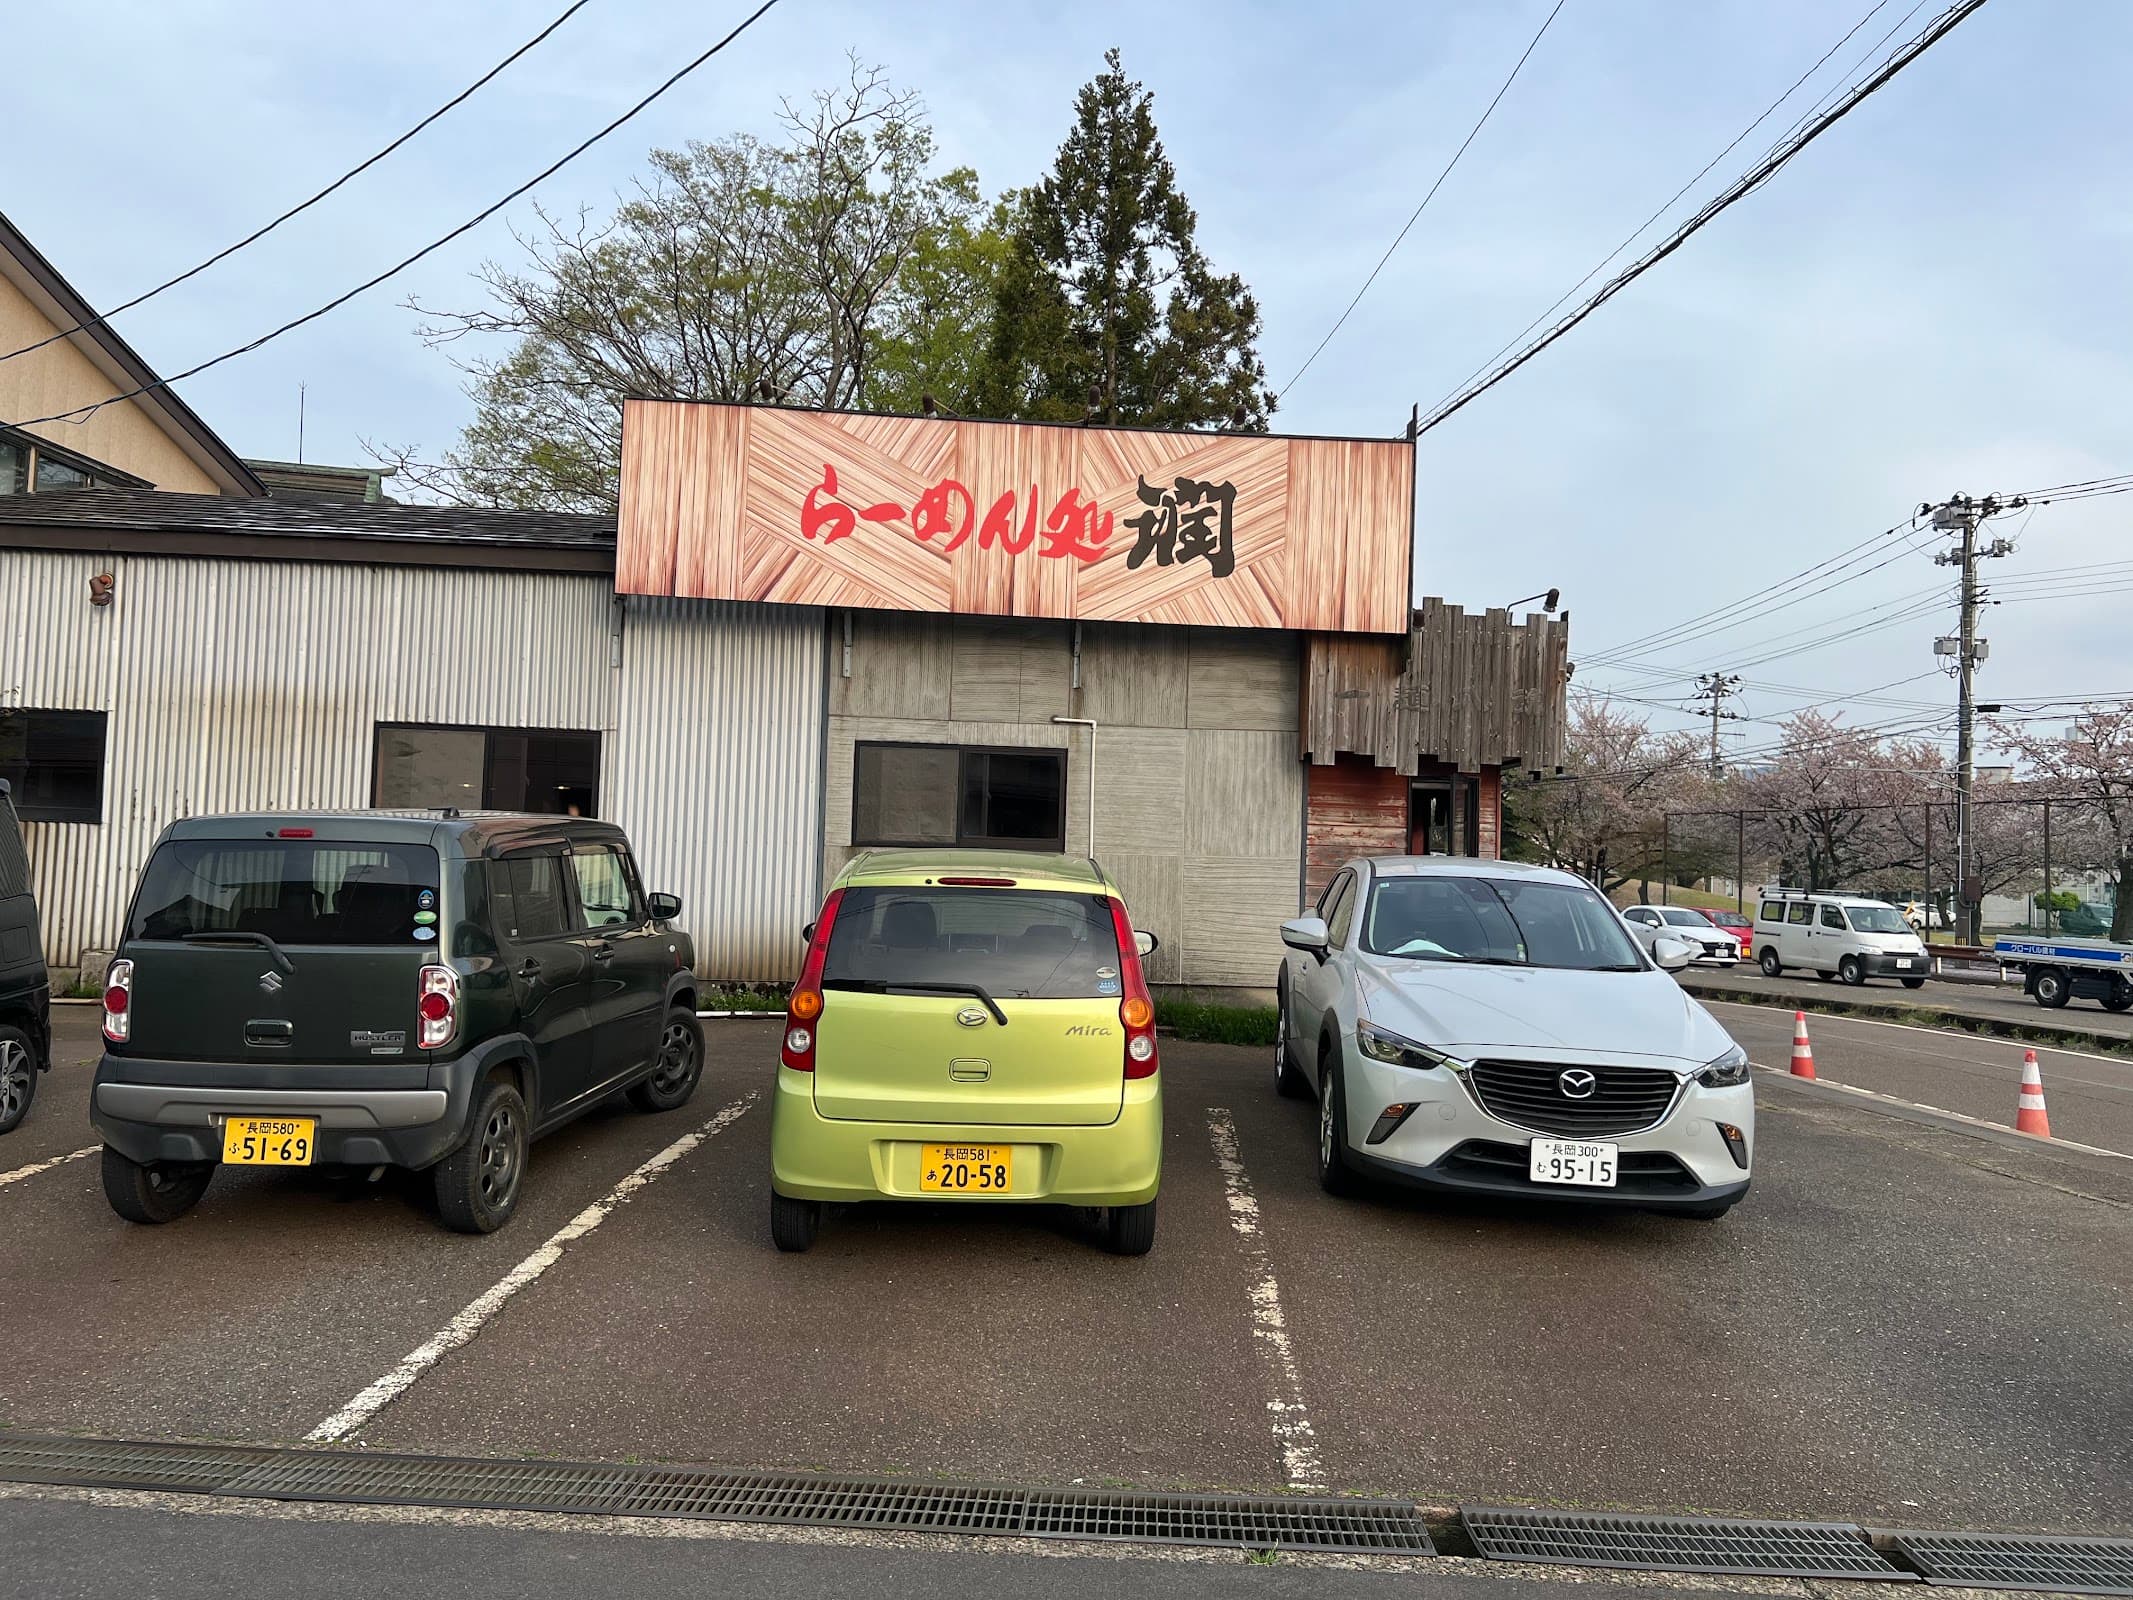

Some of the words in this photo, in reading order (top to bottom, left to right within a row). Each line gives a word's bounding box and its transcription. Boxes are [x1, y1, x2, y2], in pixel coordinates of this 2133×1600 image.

[800, 464, 1114, 563] らーめん処
[1123, 474, 1237, 578] 潤
[1065, 1025, 1112, 1036] Mira
[247, 1122, 294, 1135] 長岡580
[228, 1142, 240, 1154] ふ
[242, 1137, 307, 1161] 51-69
[943, 1147, 990, 1161] 長岡581
[1552, 1143, 1598, 1157] 長岡300
[926, 1169, 937, 1182] あ
[940, 1164, 1006, 1188] 20-58
[1550, 1158, 1612, 1182] 95-15
